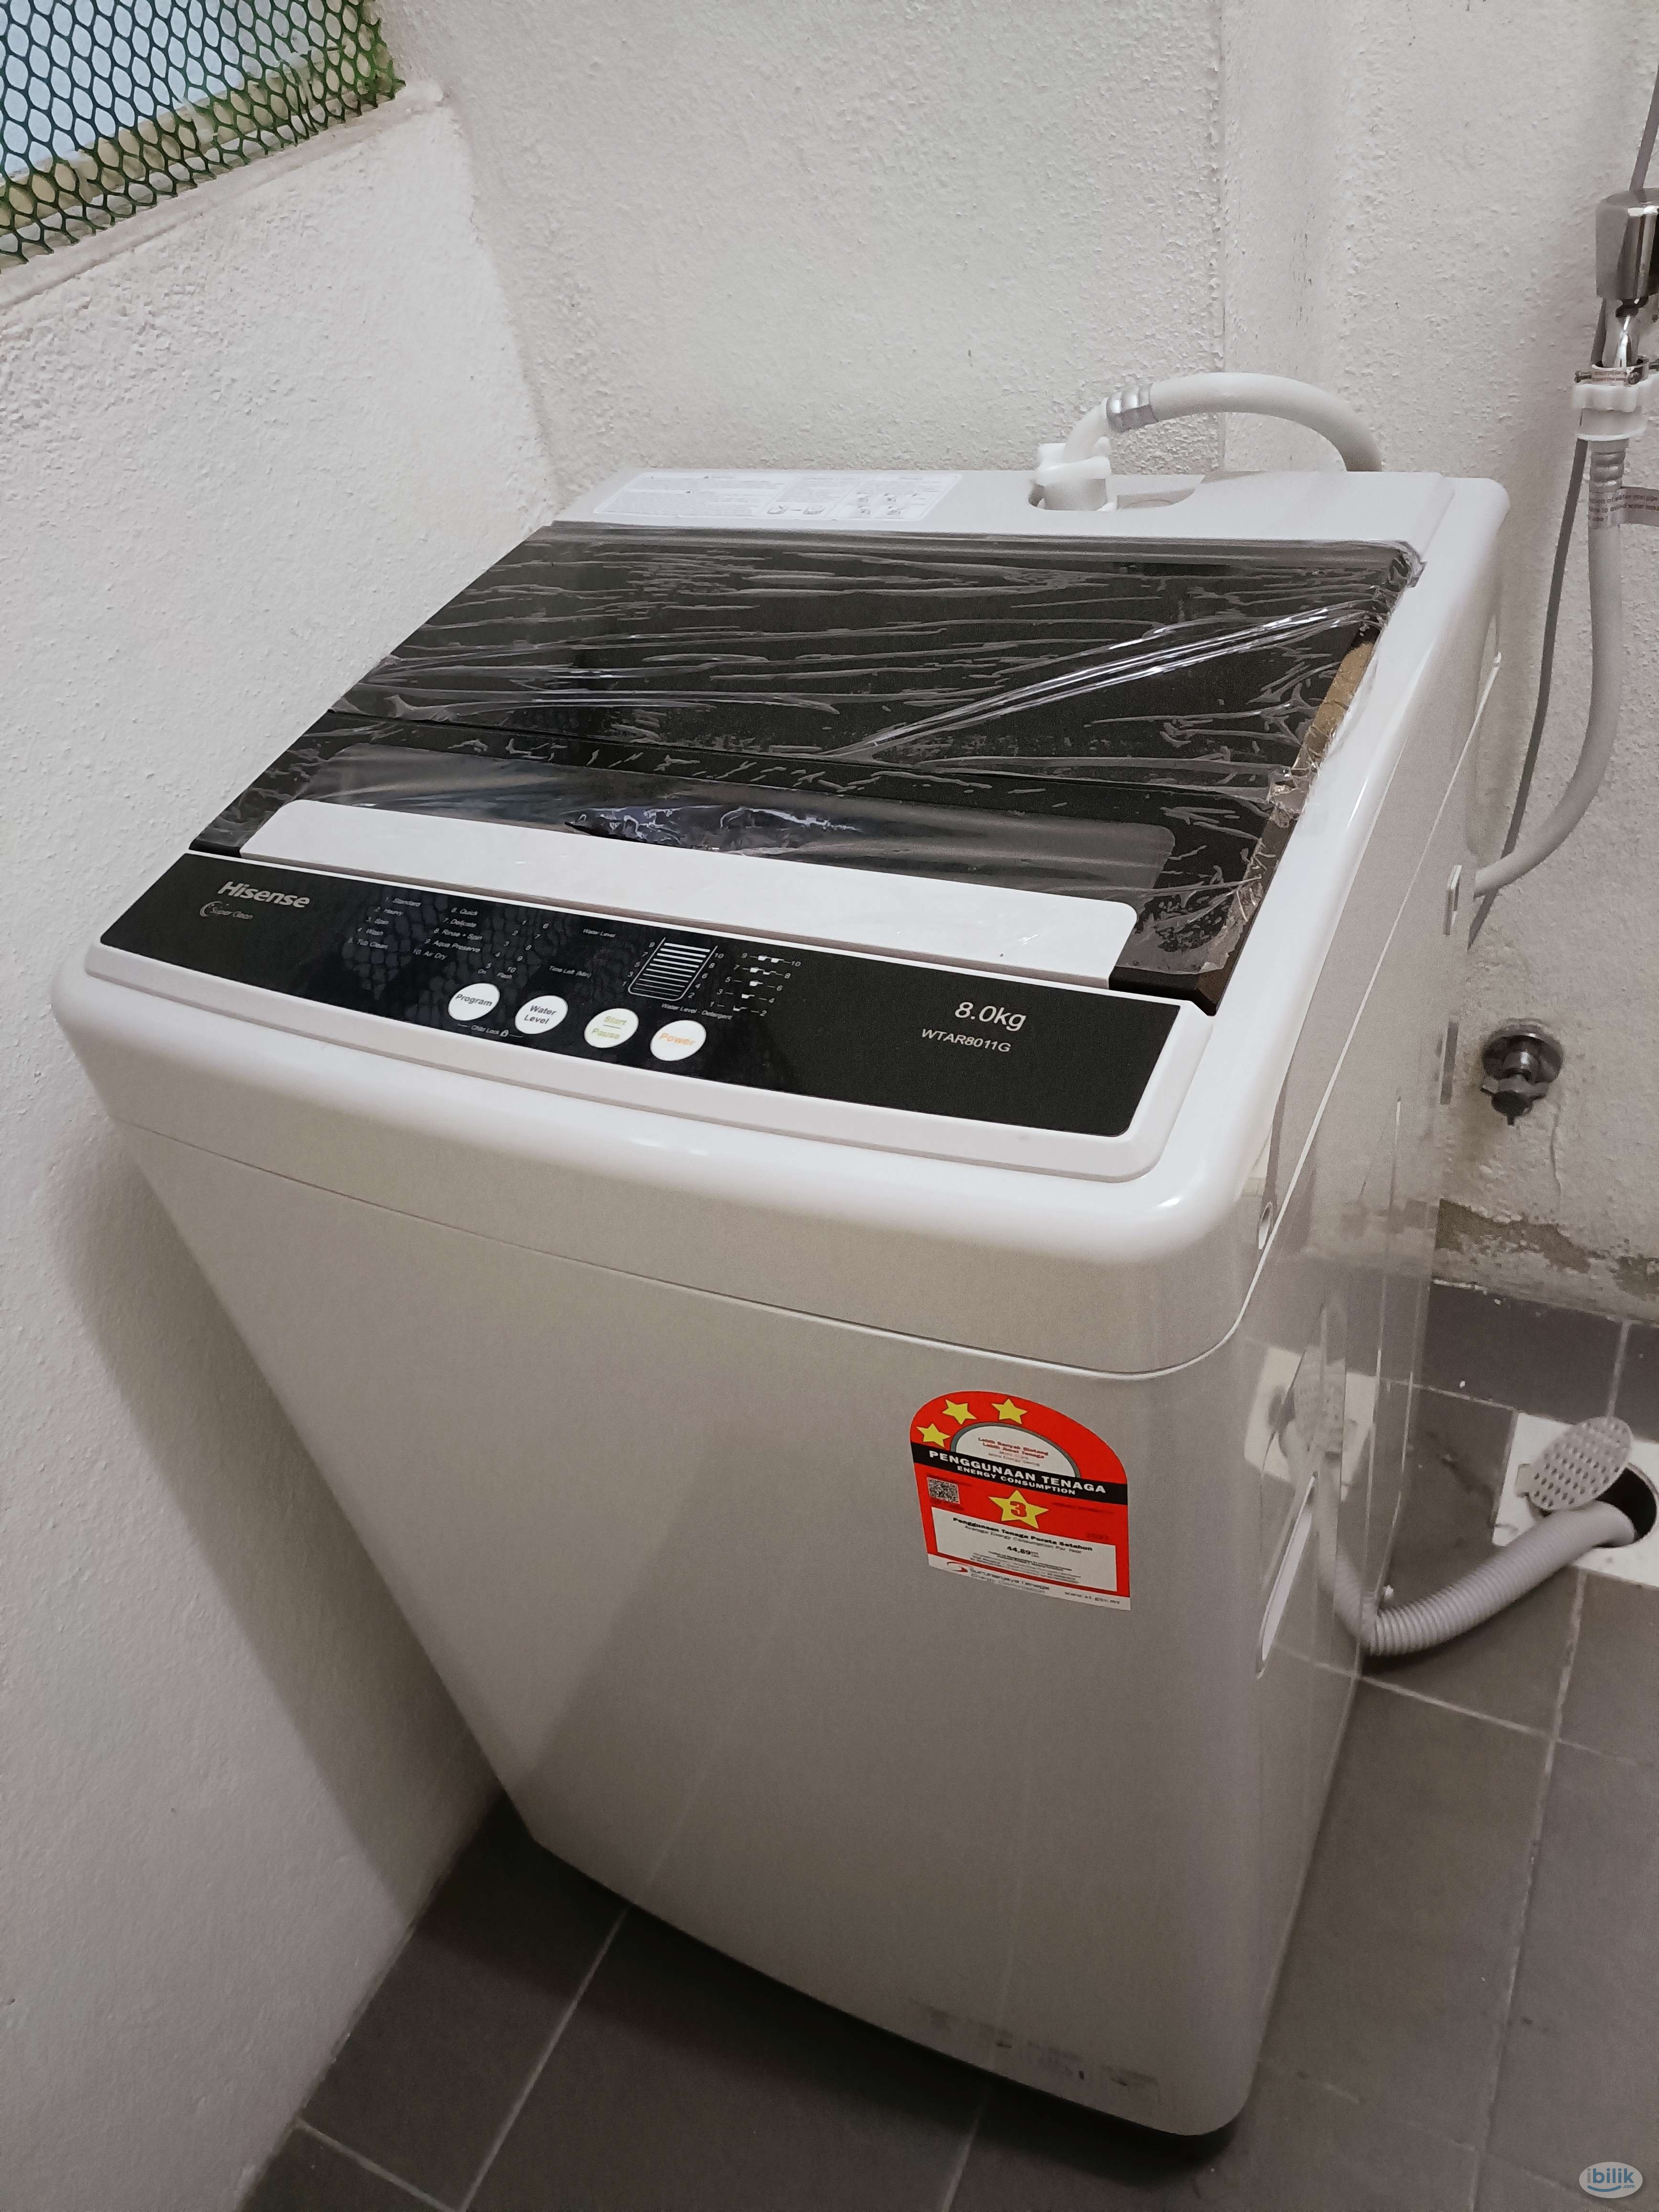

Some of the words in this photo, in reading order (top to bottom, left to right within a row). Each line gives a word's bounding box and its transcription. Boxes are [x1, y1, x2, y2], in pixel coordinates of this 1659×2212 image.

[218, 881, 310, 908] Hisense
[393, 898, 421, 907] Standard
[383, 908, 404, 917] Heavy
[450, 919, 476, 928] Delicate
[369, 941, 388, 950] Clean
[452, 943, 481, 952] Preserve
[455, 994, 493, 1006] Program
[530, 1005, 557, 1016] Water
[661, 1003, 680, 1011] Water
[701, 1010, 732, 1020] Detergent
[955, 1002, 1026, 1031] 8.0kg
[524, 1014, 550, 1024] Level
[604, 1016, 627, 1026] Start
[591, 1028, 620, 1040] Pause
[659, 1033, 696, 1046] Power
[922, 1029, 1011, 1052] WTAR8011G
[929, 1450, 1036, 1481] PENGGUNAAN
[1041, 1476, 1106, 1493] TENAGA
[957, 1466, 996, 1479] ENERGY
[1001, 1476, 1075, 1495] CONSUMPTION
[1010, 1501, 1027, 1517] 3
[953, 1517, 999, 1532] Penggunaan
[1002, 1529, 1028, 1538] Tenaga
[1059, 1541, 1093, 1551] Setahun
